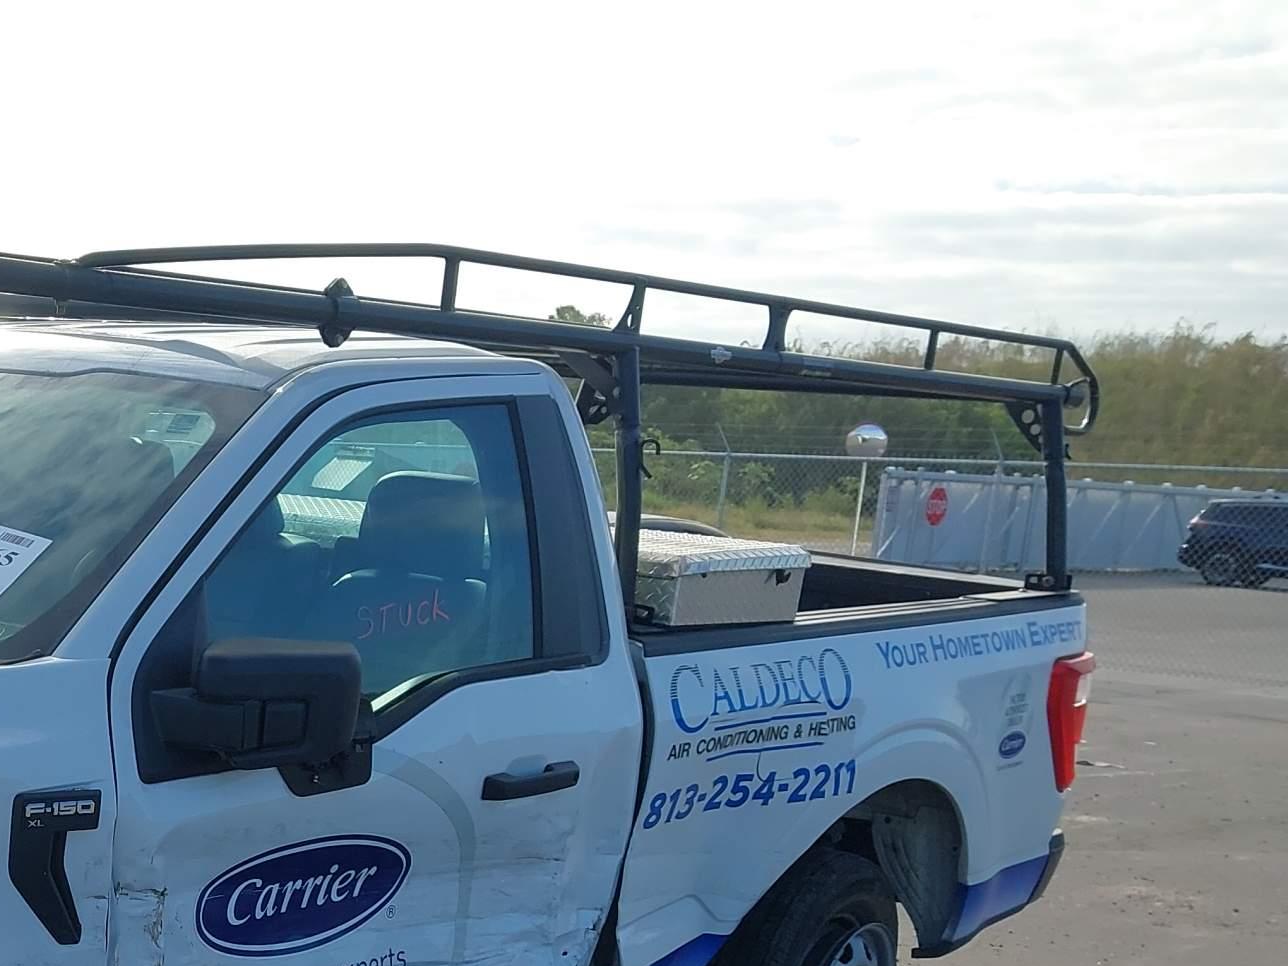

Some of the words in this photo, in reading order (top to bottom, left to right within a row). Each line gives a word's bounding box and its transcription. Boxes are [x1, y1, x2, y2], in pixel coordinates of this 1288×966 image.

[357, 588, 450, 639] STUCK
[876, 641, 928, 669] YOUR
[930, 628, 1028, 662] HOMETOWN
[1026, 620, 1082, 647] EXPERT
[670, 648, 852, 734] CALDECO
[667, 743, 692, 761] AIR
[697, 725, 788, 755] CONDITIONING
[793, 726, 803, 739] &
[25, 800, 95, 817] F-150
[643, 759, 856, 829] 813-254-2211
[27, 820, 44, 828] XL
[226, 864, 378, 926] Carrier
